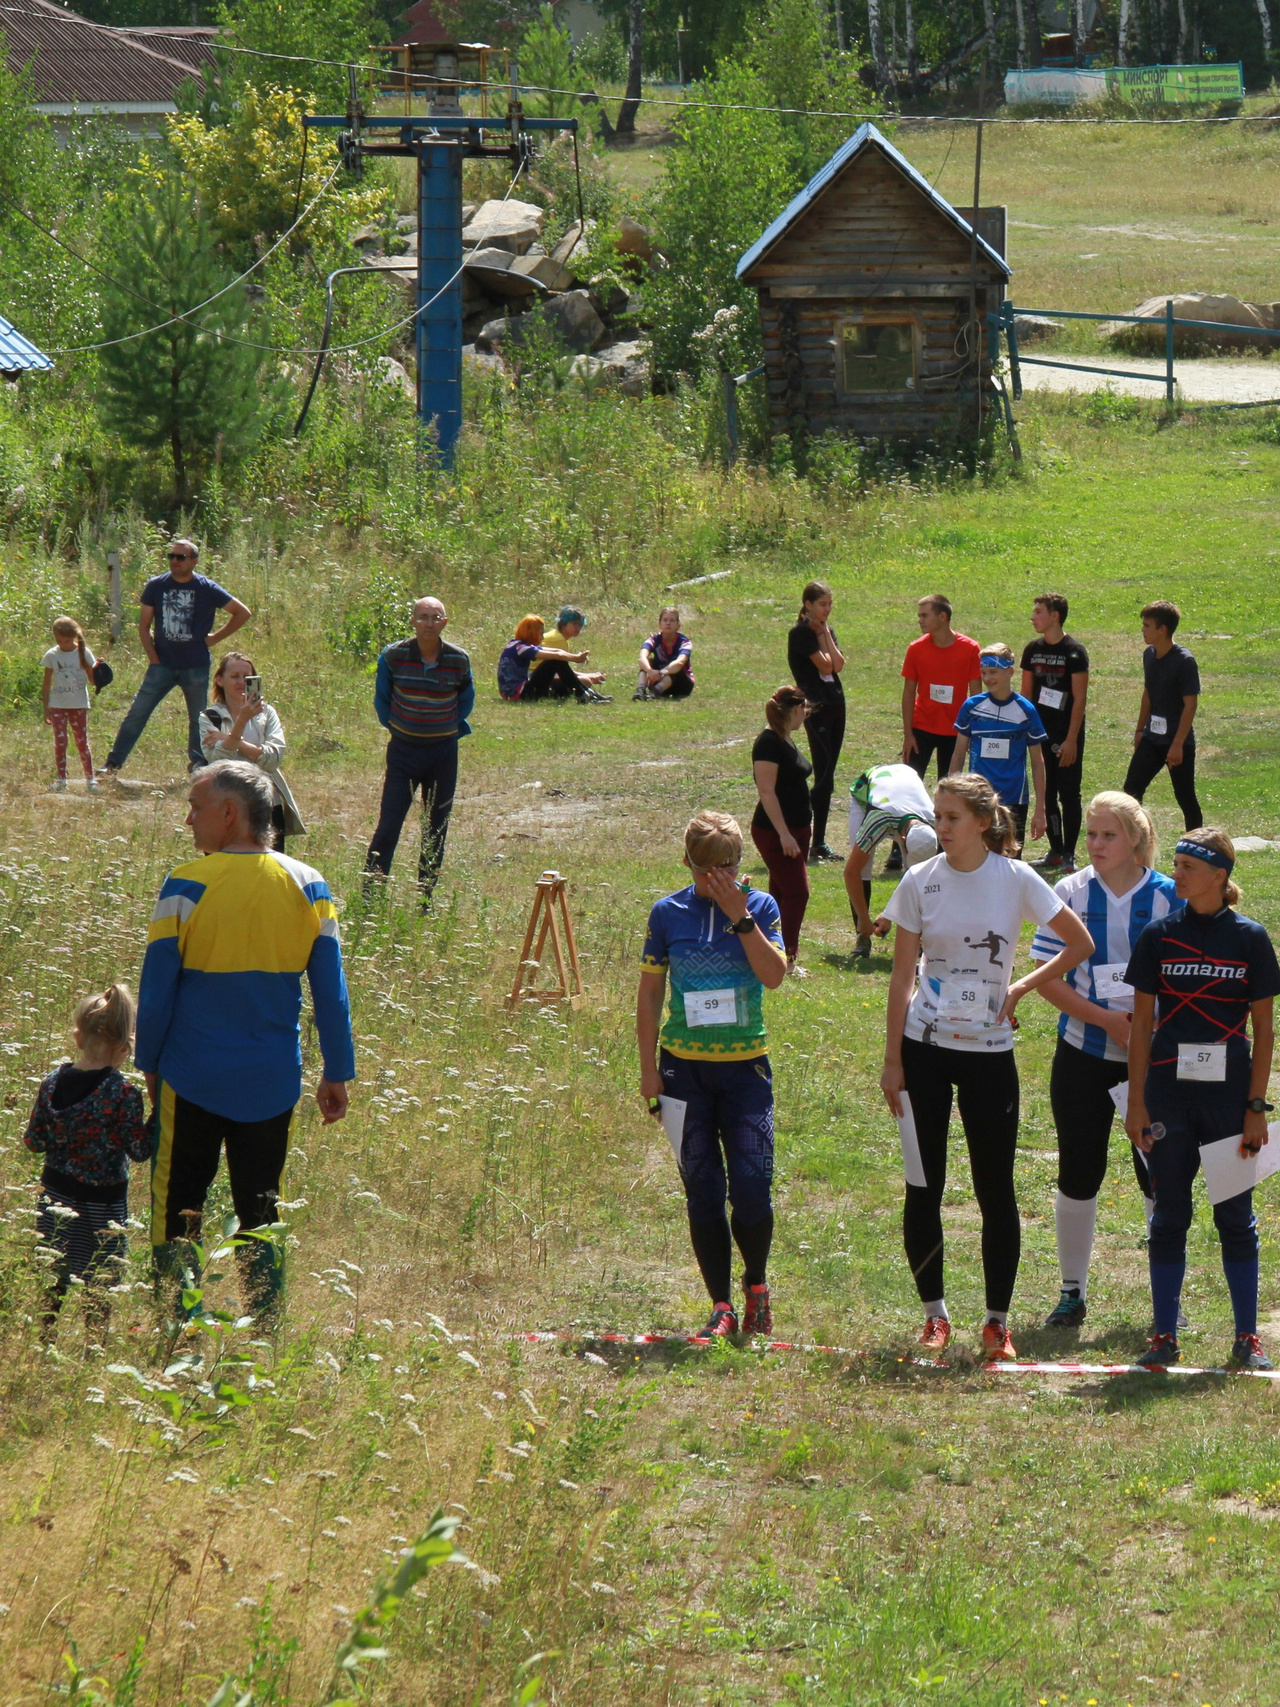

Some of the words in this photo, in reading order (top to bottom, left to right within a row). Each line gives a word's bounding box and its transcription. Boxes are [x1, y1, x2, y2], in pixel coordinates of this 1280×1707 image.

[1123, 69, 1169, 86] МИНСПОРТ
[923, 884, 941, 894] 2021
[1160, 963, 1247, 979] noname
[961, 991, 976, 1001] 58
[704, 998, 719, 1009] 59
[1197, 1052, 1212, 1063] 57
